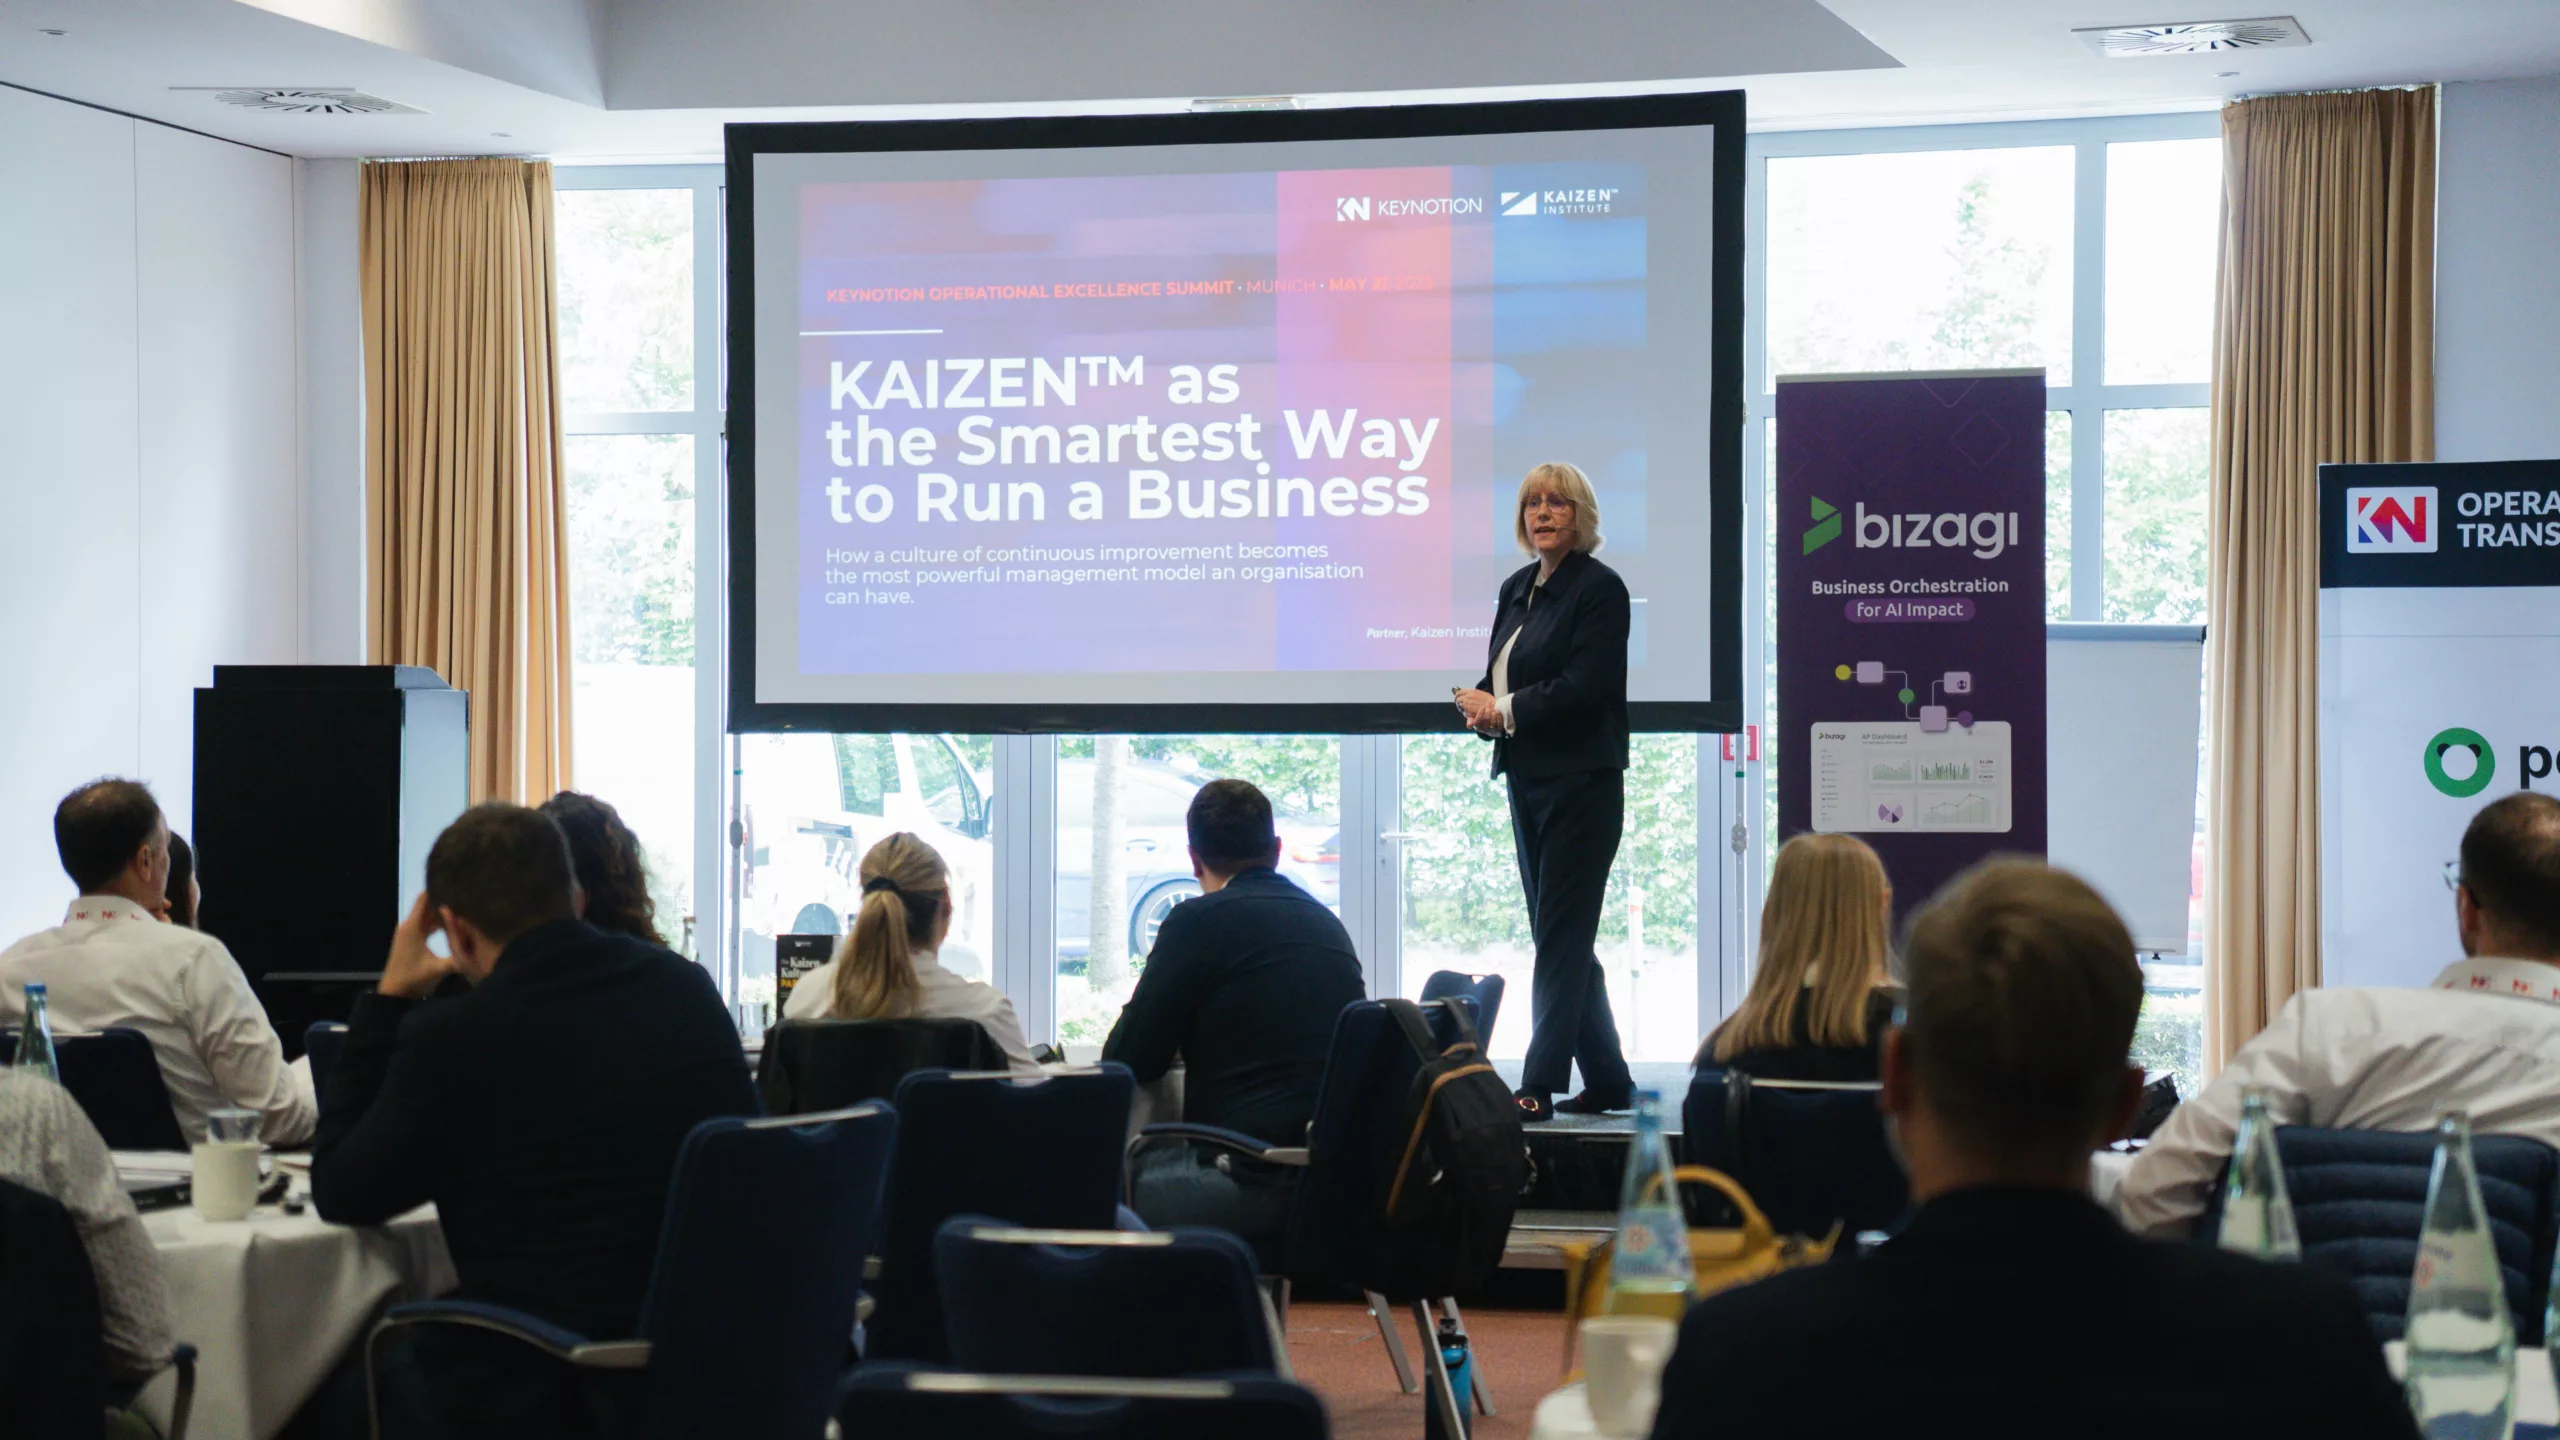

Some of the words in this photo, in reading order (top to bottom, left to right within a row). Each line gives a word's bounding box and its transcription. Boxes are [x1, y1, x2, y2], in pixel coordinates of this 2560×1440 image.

[1378, 197, 1483, 217] KEYNOTION
[1544, 204, 1611, 214] INSTITUTE
[827, 287, 925, 303] KEYNOTION
[929, 285, 1050, 301] OPERATIONAL
[1054, 282, 1162, 298] EXCELLENCE
[1166, 280, 1235, 296] SUMMIT
[1247, 278, 1316, 294] MUNICH
[1329, 276, 1367, 292] MAY
[1167, 363, 1240, 404] as
[825, 414, 937, 467] the
[957, 413, 1263, 466] Smartest
[1282, 408, 1441, 471] Way
[825, 477, 894, 524] to
[917, 473, 1045, 522] Run
[1068, 481, 1103, 521] a
[1128, 461, 1430, 520] Business
[1855, 502, 2019, 560] bizagi
[826, 548, 869, 564] How
[874, 551, 885, 563] a
[890, 547, 958, 563] culture
[963, 546, 983, 562] of
[986, 545, 1095, 562] continuous
[1100, 544, 1233, 564] improvement
[1239, 543, 1329, 559] becomes
[825, 568, 857, 584] the
[862, 568, 910, 583] most
[916, 566, 1001, 587] powerful
[1006, 566, 1139, 585] management
[1145, 564, 1206, 580] model
[1212, 567, 1235, 580] an
[1241, 562, 1364, 583] organisation
[825, 590, 859, 604] can
[865, 588, 915, 604] have.
[1812, 579, 1885, 595] Business
[1889, 577, 2009, 595] Orchestration
[1857, 602, 1882, 617] for
[1885, 603, 1902, 617] AI
[1907, 602, 1964, 619] Impact
[1366, 627, 1408, 640] Partner,
[1411, 626, 1454, 638] Kaizen
